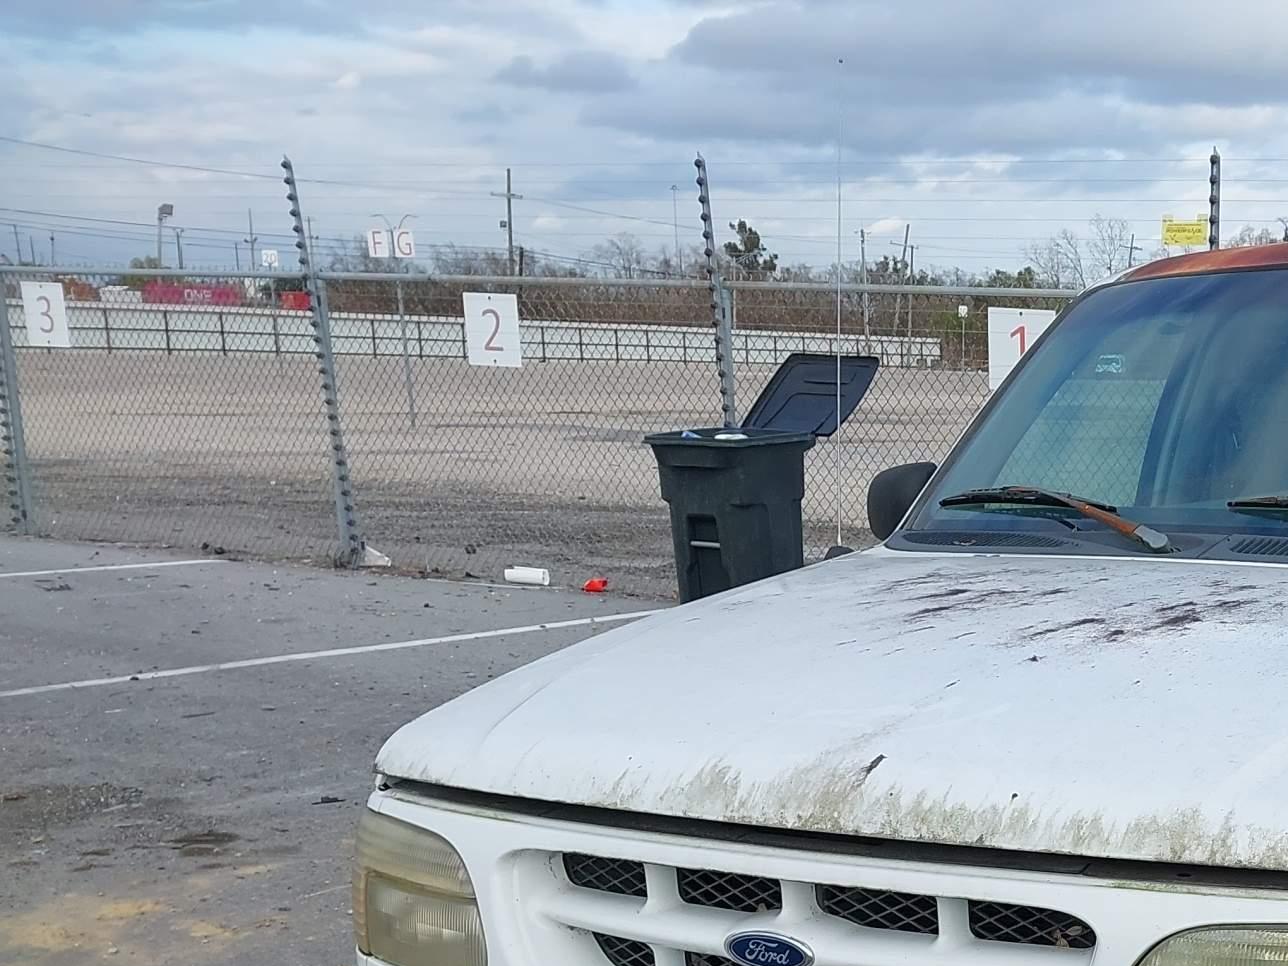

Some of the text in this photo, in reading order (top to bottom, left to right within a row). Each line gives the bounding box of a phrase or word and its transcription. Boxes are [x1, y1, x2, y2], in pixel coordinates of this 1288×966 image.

[371, 231, 383, 256] F
[397, 231, 412, 256] G
[36, 295, 54, 334] 3
[481, 308, 504, 351] 2
[1010, 325, 1026, 357] 1
[744, 939, 790, 965] Ford
